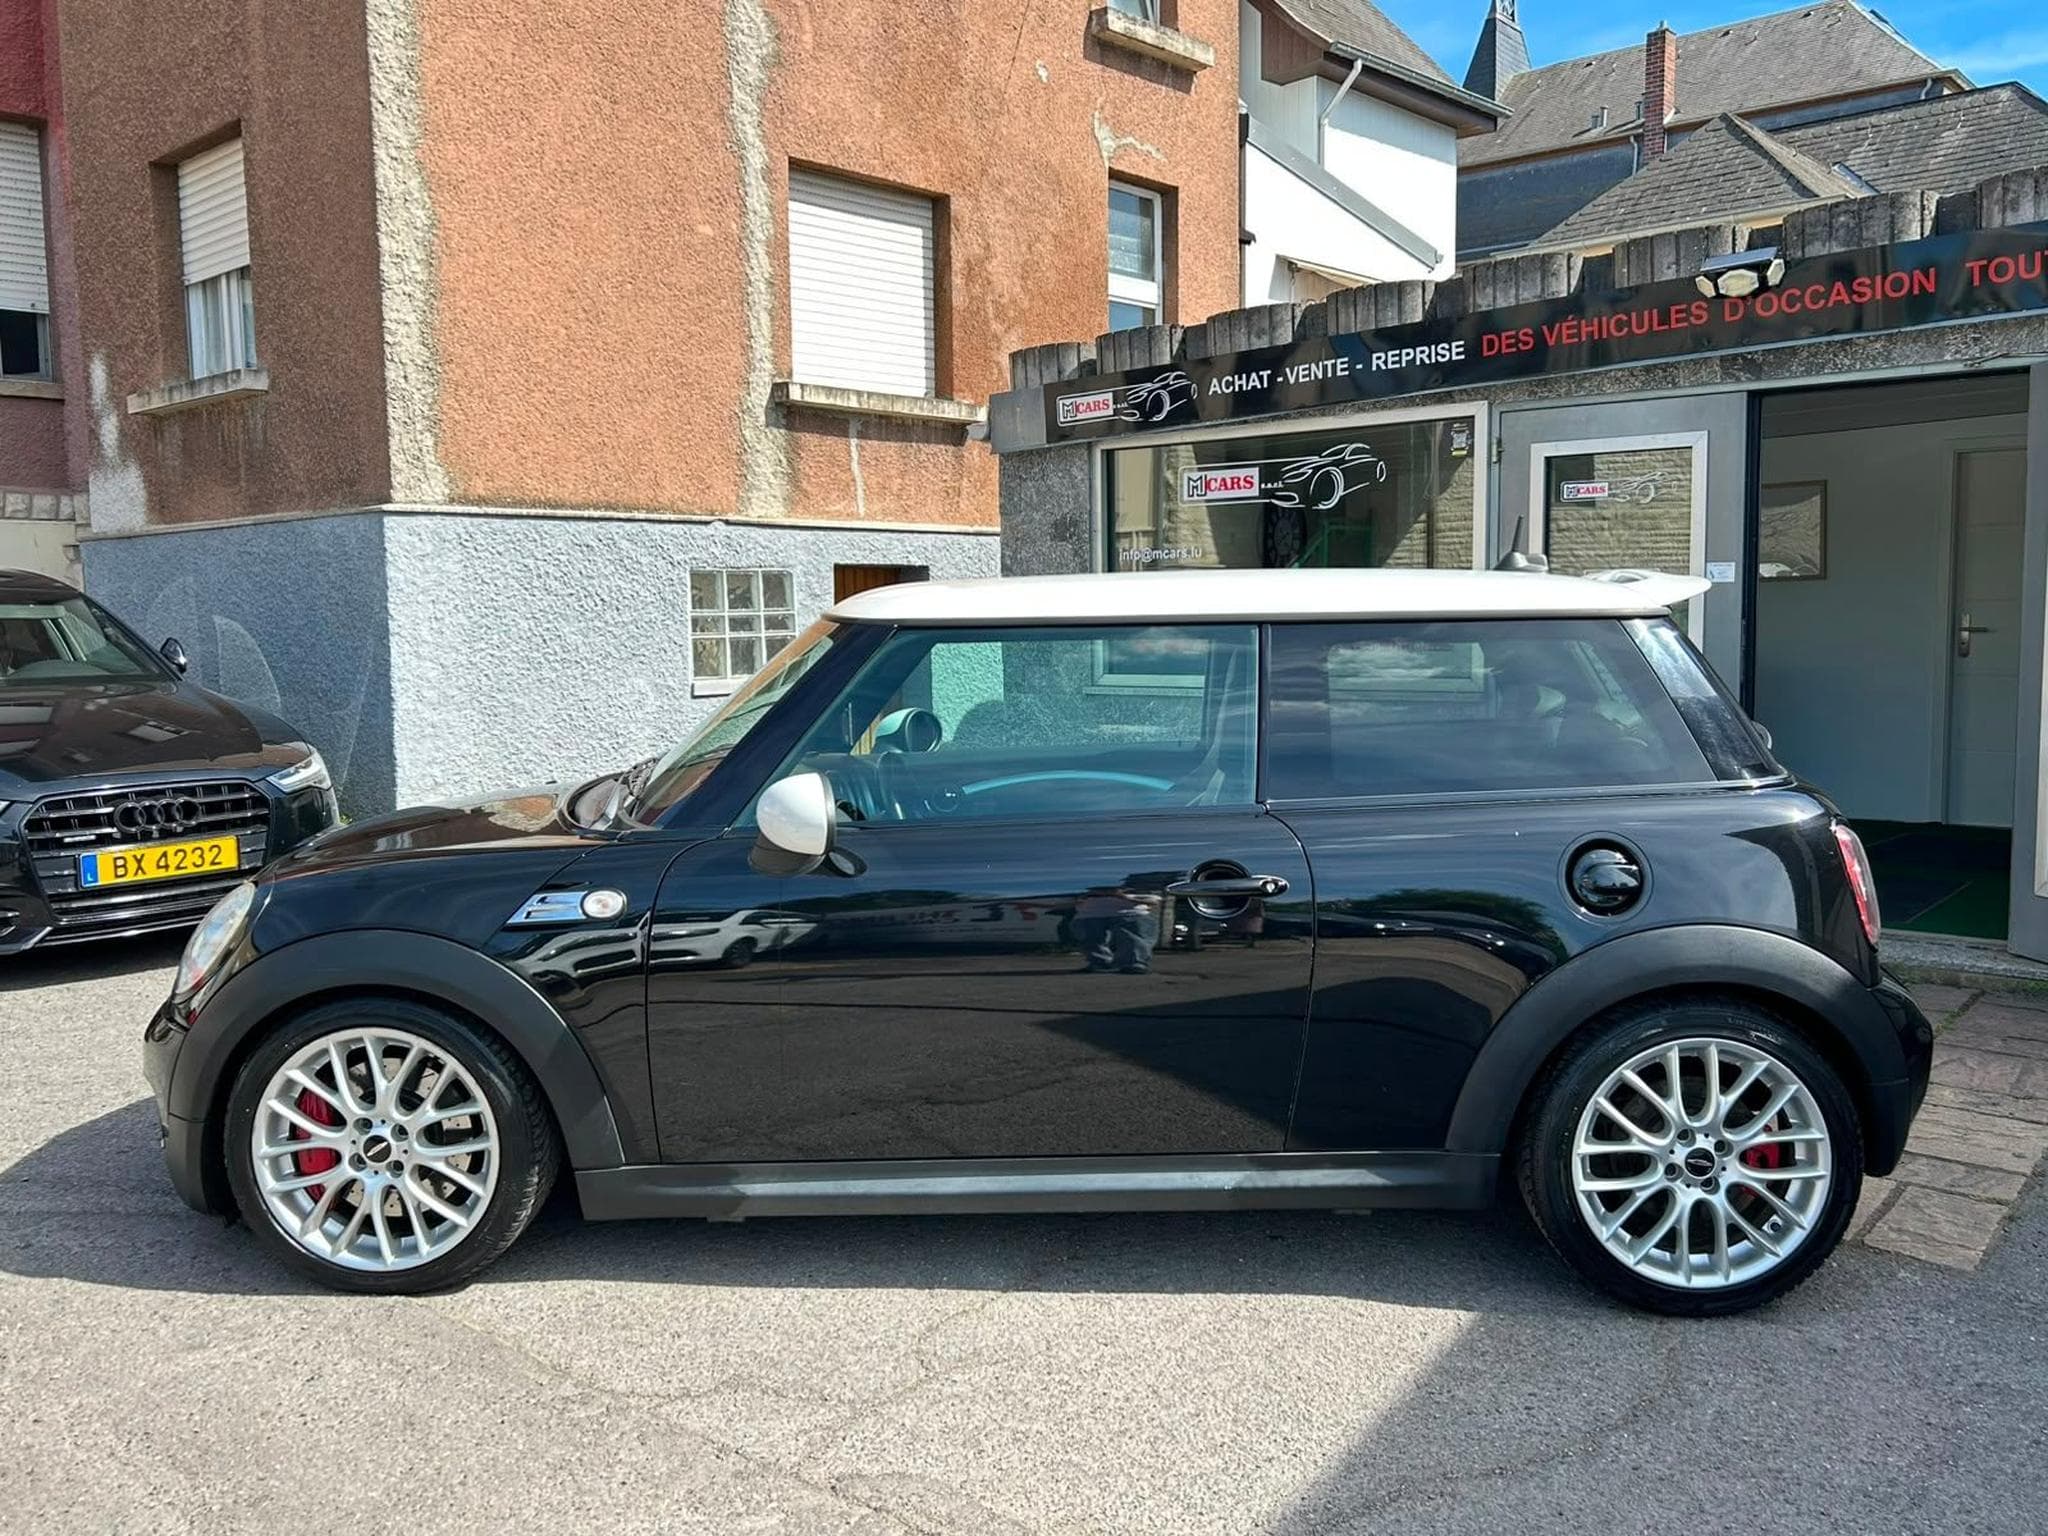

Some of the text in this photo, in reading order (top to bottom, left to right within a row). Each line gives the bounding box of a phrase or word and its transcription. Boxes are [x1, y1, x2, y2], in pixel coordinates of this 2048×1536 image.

[1208, 370, 1272, 396] ACHAT
[1371, 340, 1466, 371] REPRISE
[1482, 327, 1535, 357] DES
[1540, 300, 1709, 347] VÉHICULES
[1723, 267, 1936, 322] D'OCCASION
[1965, 250, 2048, 287] TOU
[1119, 546, 1202, 562] info@mcars.lu
[113, 844, 223, 879] BX 4232
